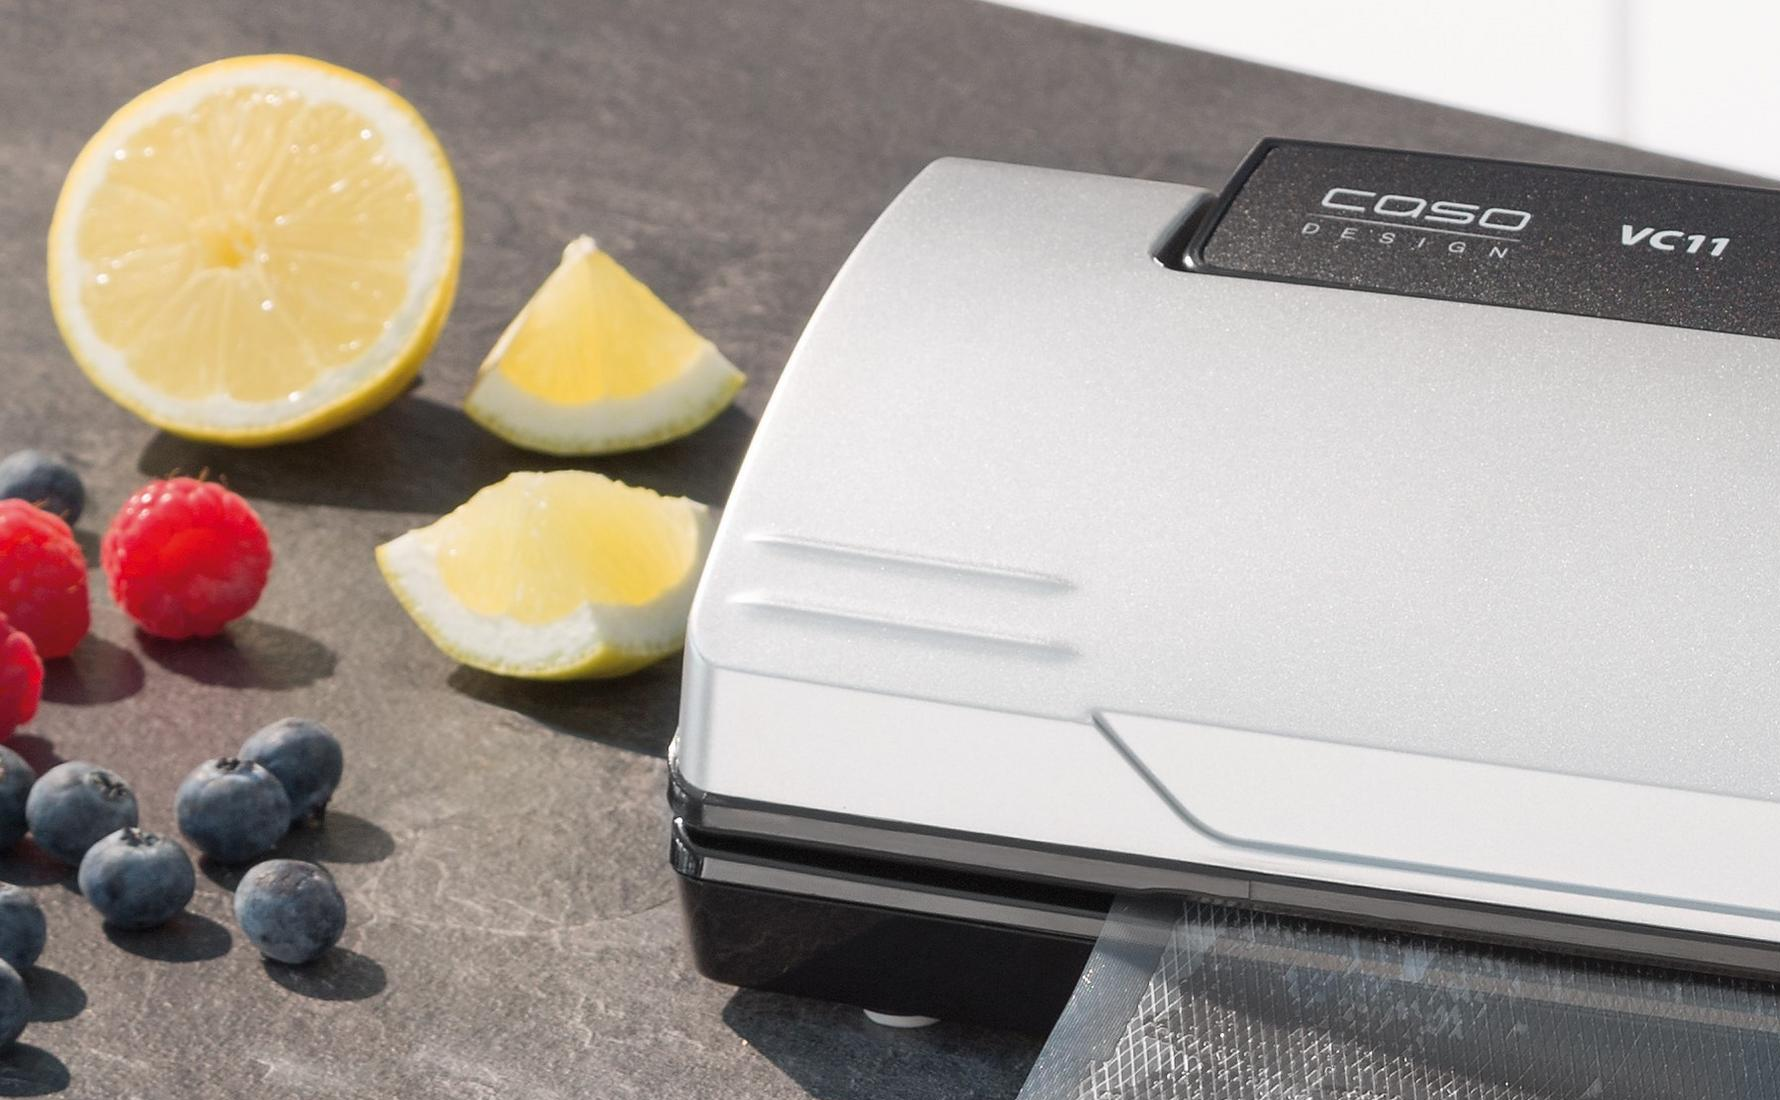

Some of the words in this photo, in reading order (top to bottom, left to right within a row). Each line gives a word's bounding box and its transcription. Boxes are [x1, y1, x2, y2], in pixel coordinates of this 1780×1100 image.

[1320, 187, 1532, 232] caso
[1301, 222, 1509, 260] DESIGN
[1620, 223, 1731, 257] VC11
